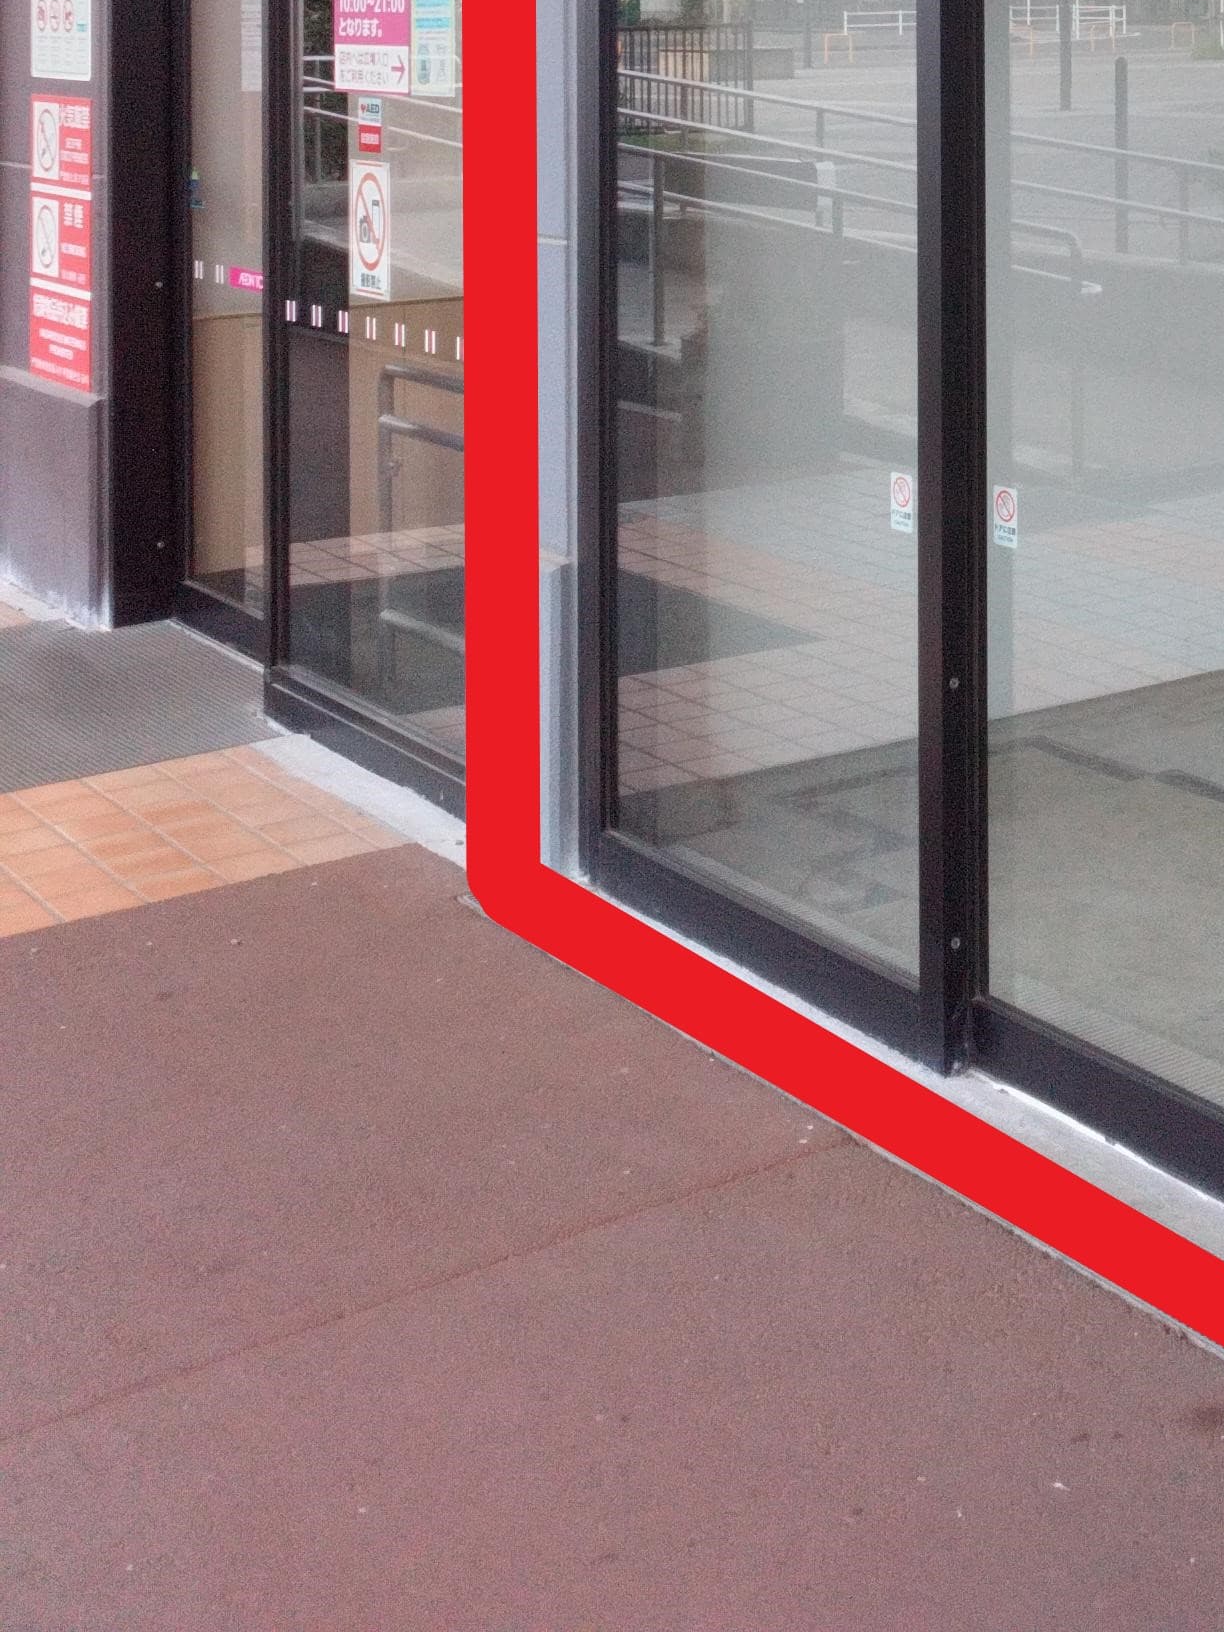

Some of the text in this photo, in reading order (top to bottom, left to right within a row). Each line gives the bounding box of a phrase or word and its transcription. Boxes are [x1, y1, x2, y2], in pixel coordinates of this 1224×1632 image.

[338, 17, 383, 38] となります。
[366, 103, 380, 114] AED
